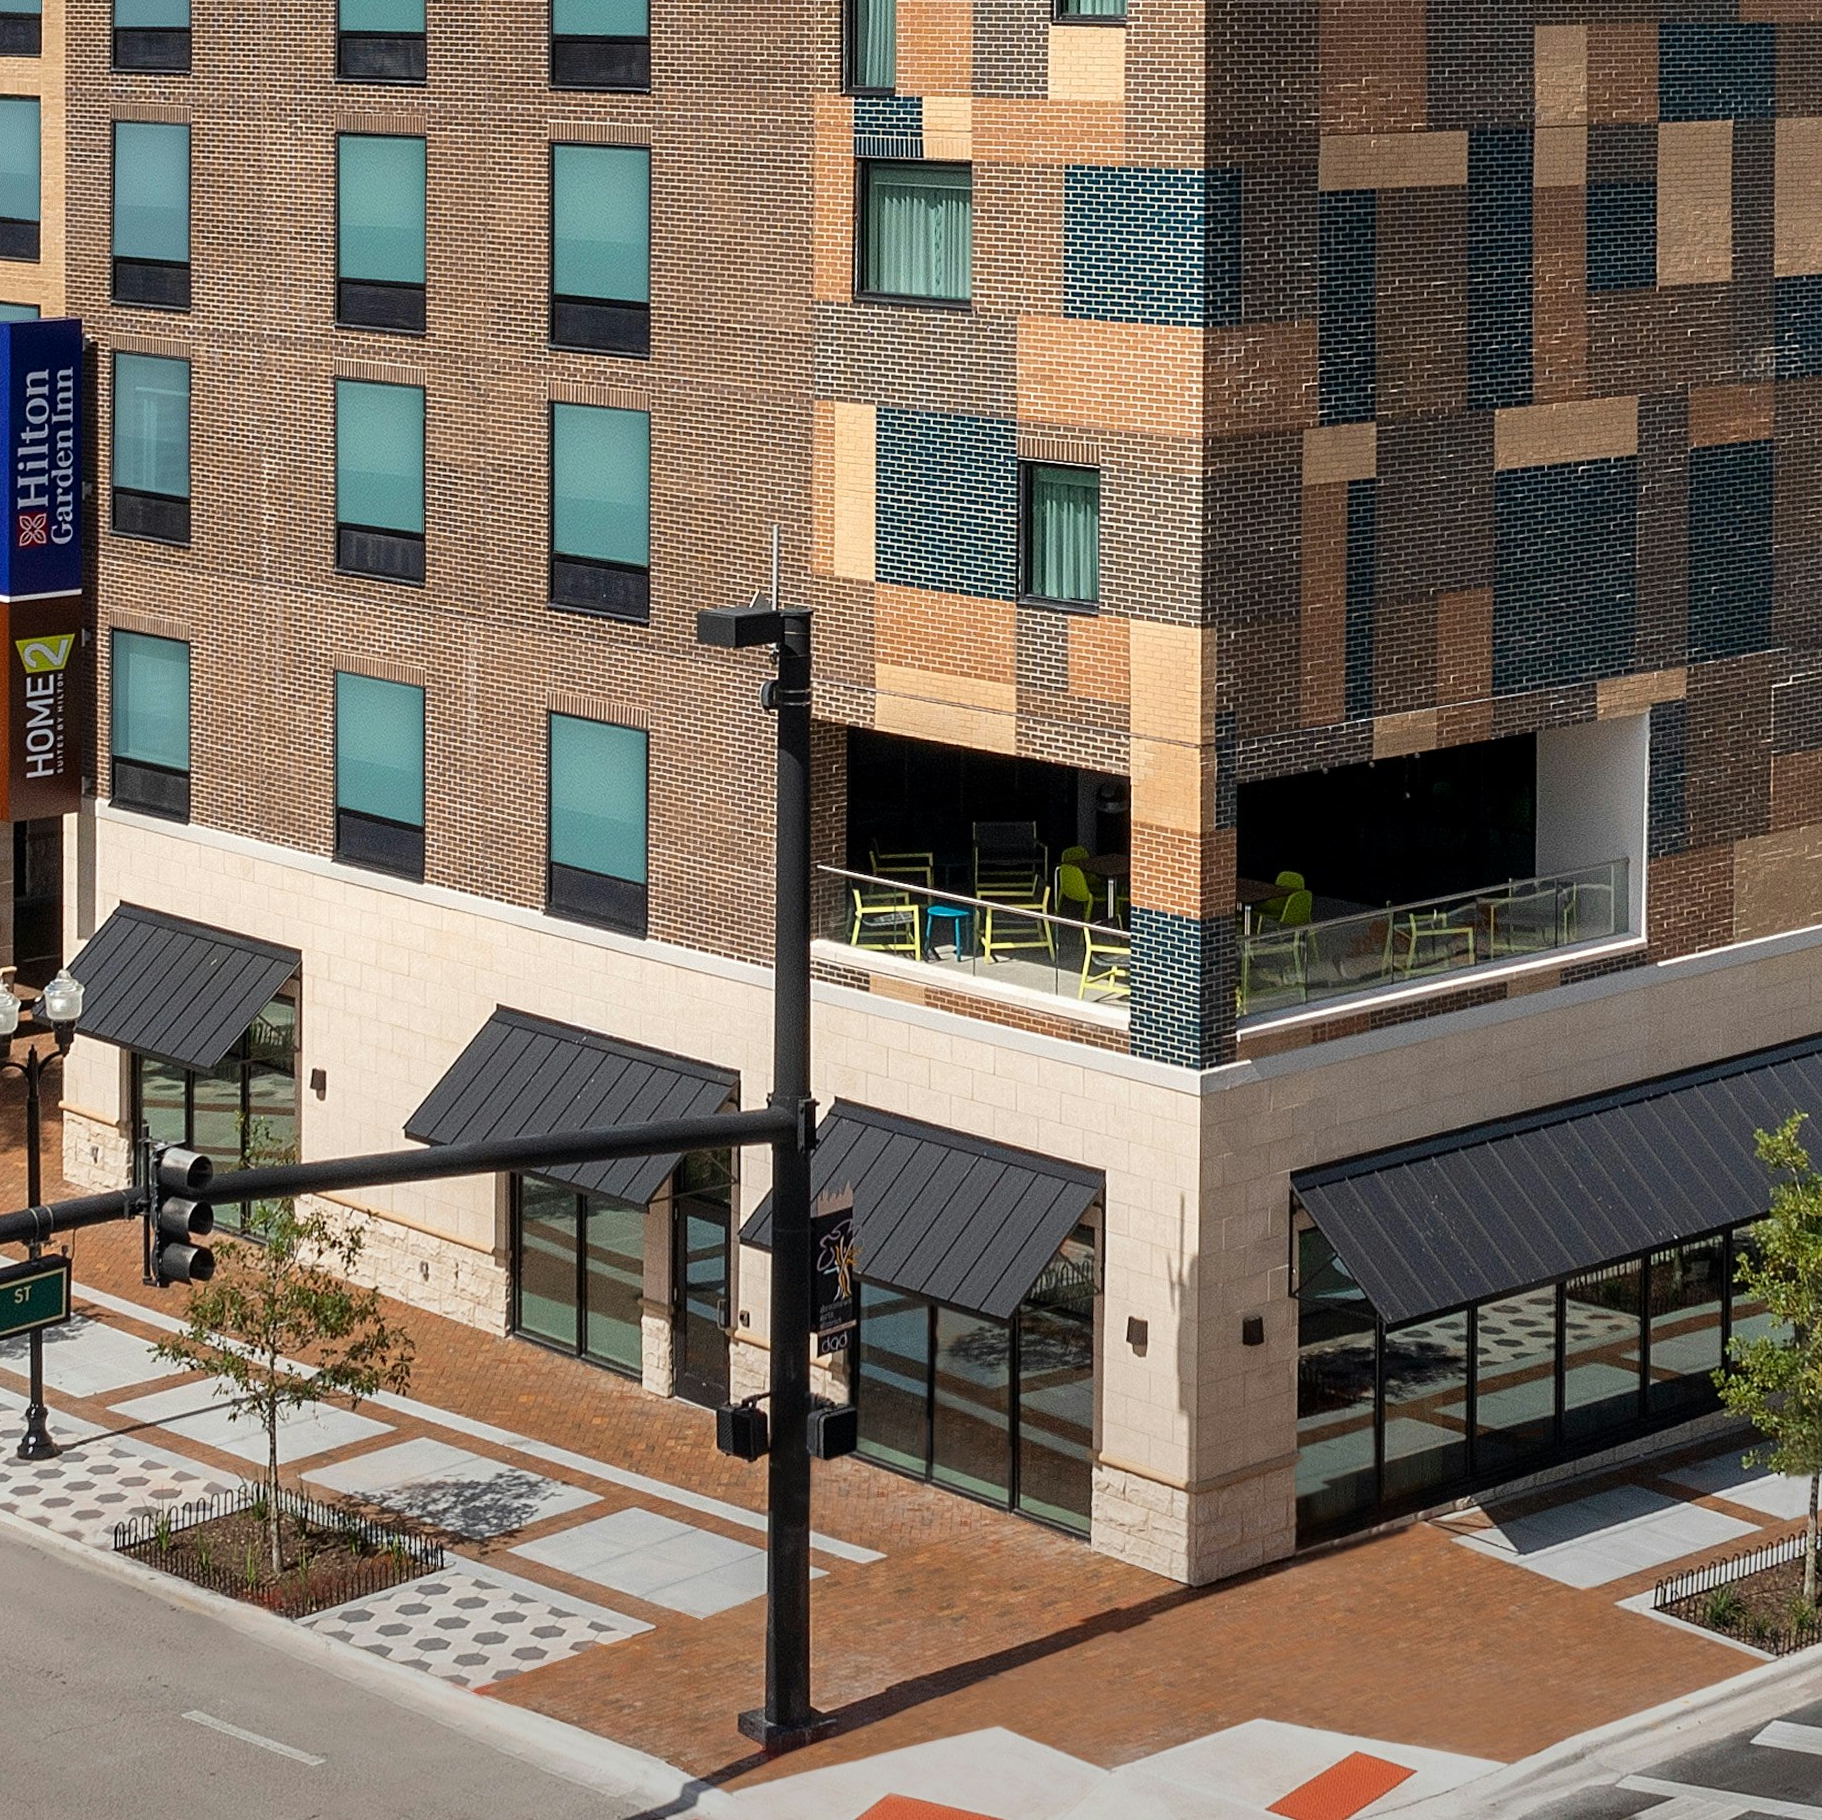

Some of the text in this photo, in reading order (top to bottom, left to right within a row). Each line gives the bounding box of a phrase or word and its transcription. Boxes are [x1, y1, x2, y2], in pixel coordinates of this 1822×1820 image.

[17, 368, 50, 510] Hilton
[50, 366, 74, 545] Garden Inn
[23, 639, 69, 779] HOME 2
[56, 673, 64, 774] SUITES BY HILTON
[14, 1285, 32, 1304] ST
